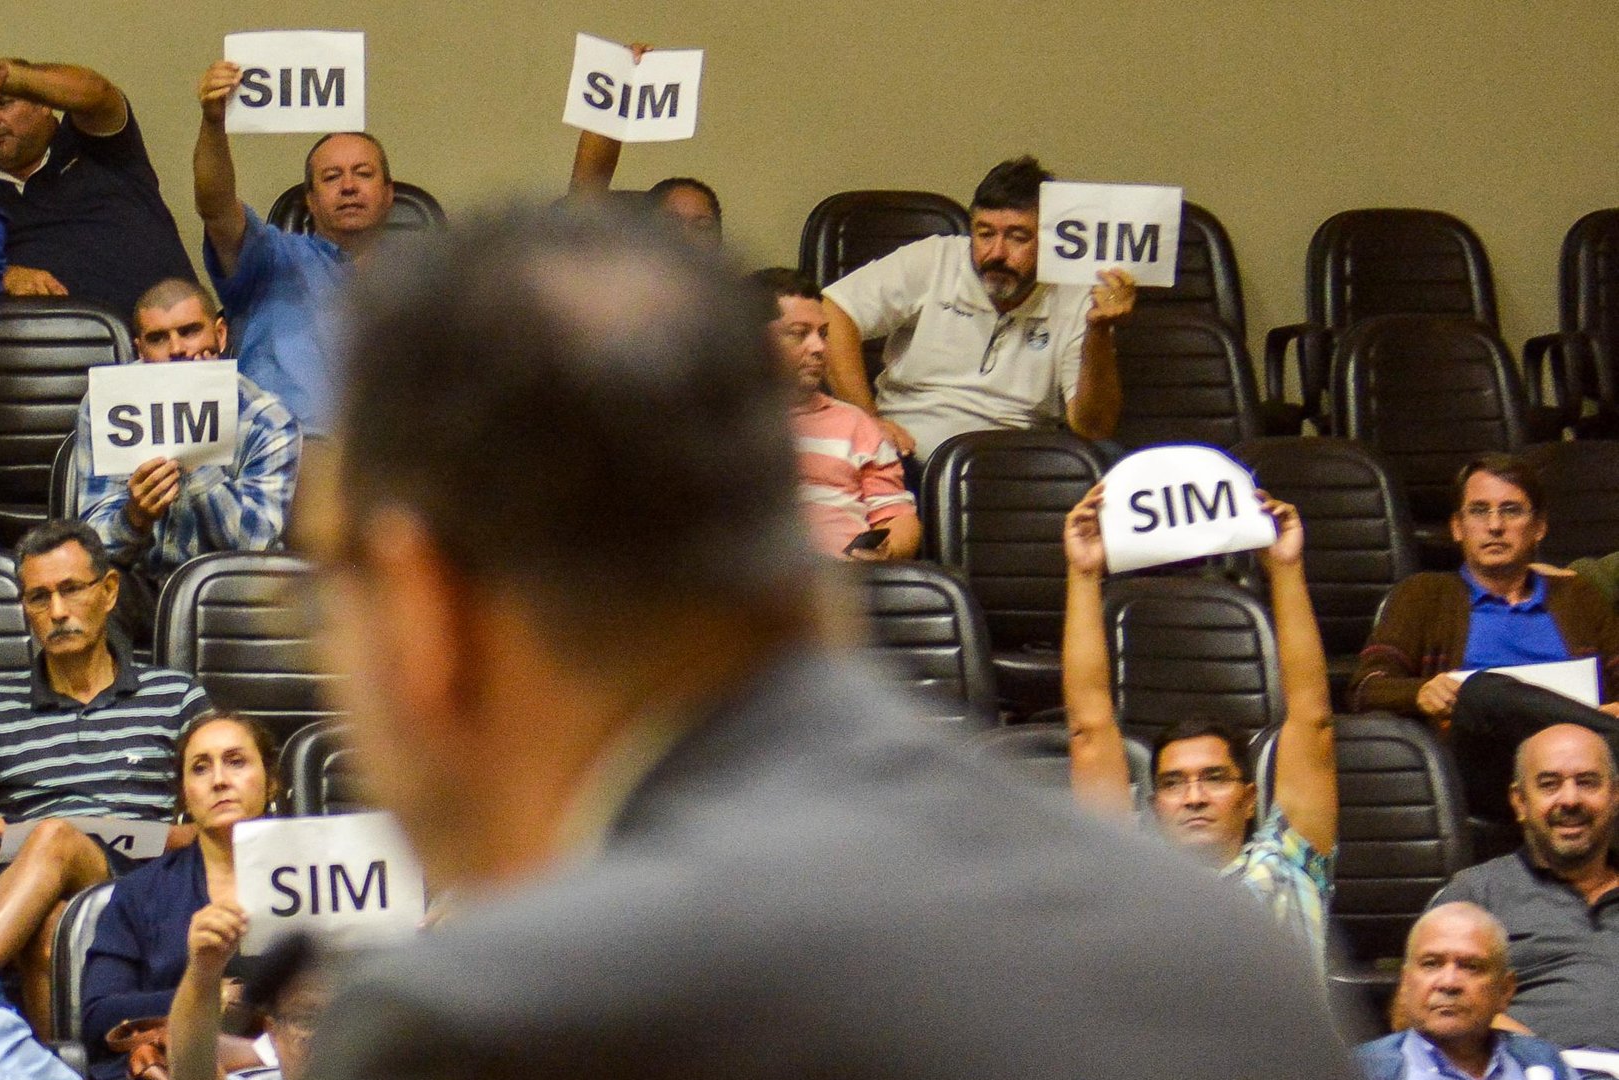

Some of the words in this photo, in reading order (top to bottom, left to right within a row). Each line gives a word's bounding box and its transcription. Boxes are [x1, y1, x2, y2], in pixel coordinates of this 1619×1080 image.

[239, 67, 344, 108] SIM
[583, 72, 680, 119] SIM
[1055, 220, 1160, 263] SIM
[107, 401, 219, 447] SIM
[1130, 481, 1236, 533] SIM
[271, 861, 387, 917] SIM
